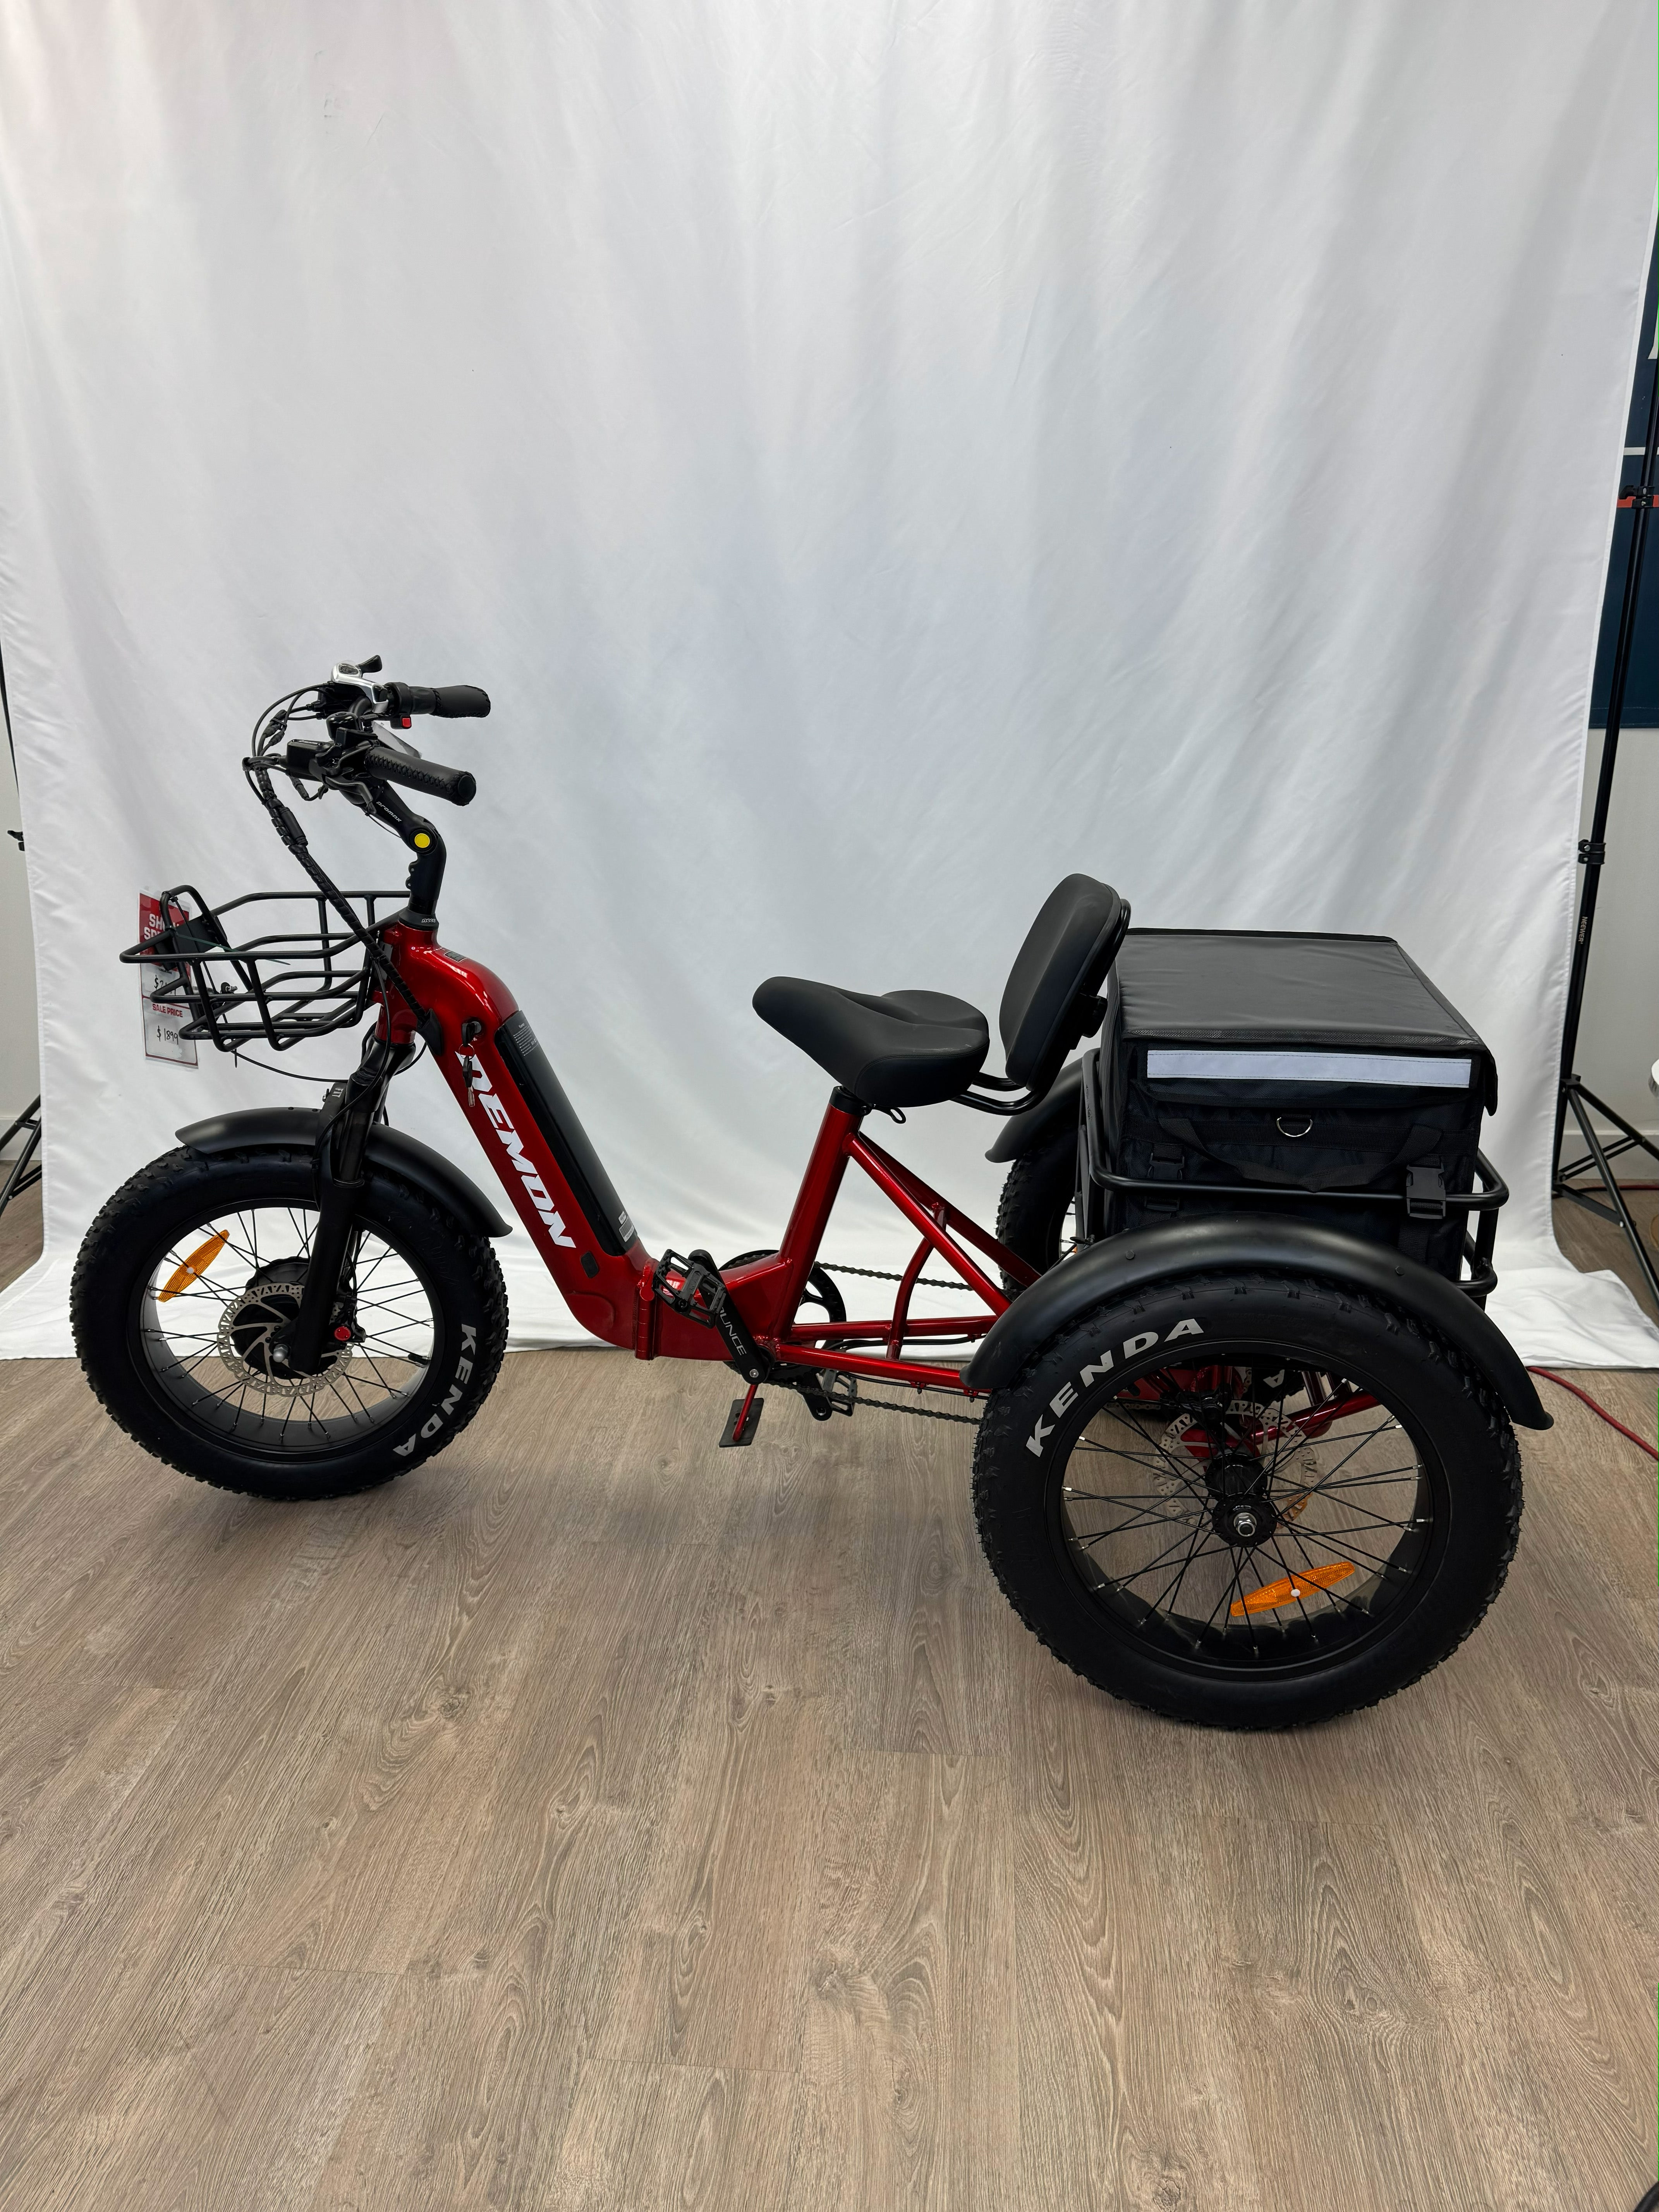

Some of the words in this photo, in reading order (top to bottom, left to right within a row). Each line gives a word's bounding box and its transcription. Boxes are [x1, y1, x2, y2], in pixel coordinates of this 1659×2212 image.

[376, 801, 402, 822] promax
[152, 1003, 166, 1013] SALE
[167, 1007, 183, 1018] PRICE
[455, 1051, 576, 1248] DEMON
[393, 1324, 476, 1456] KENDA
[1026, 1319, 1204, 1457] KENDA
